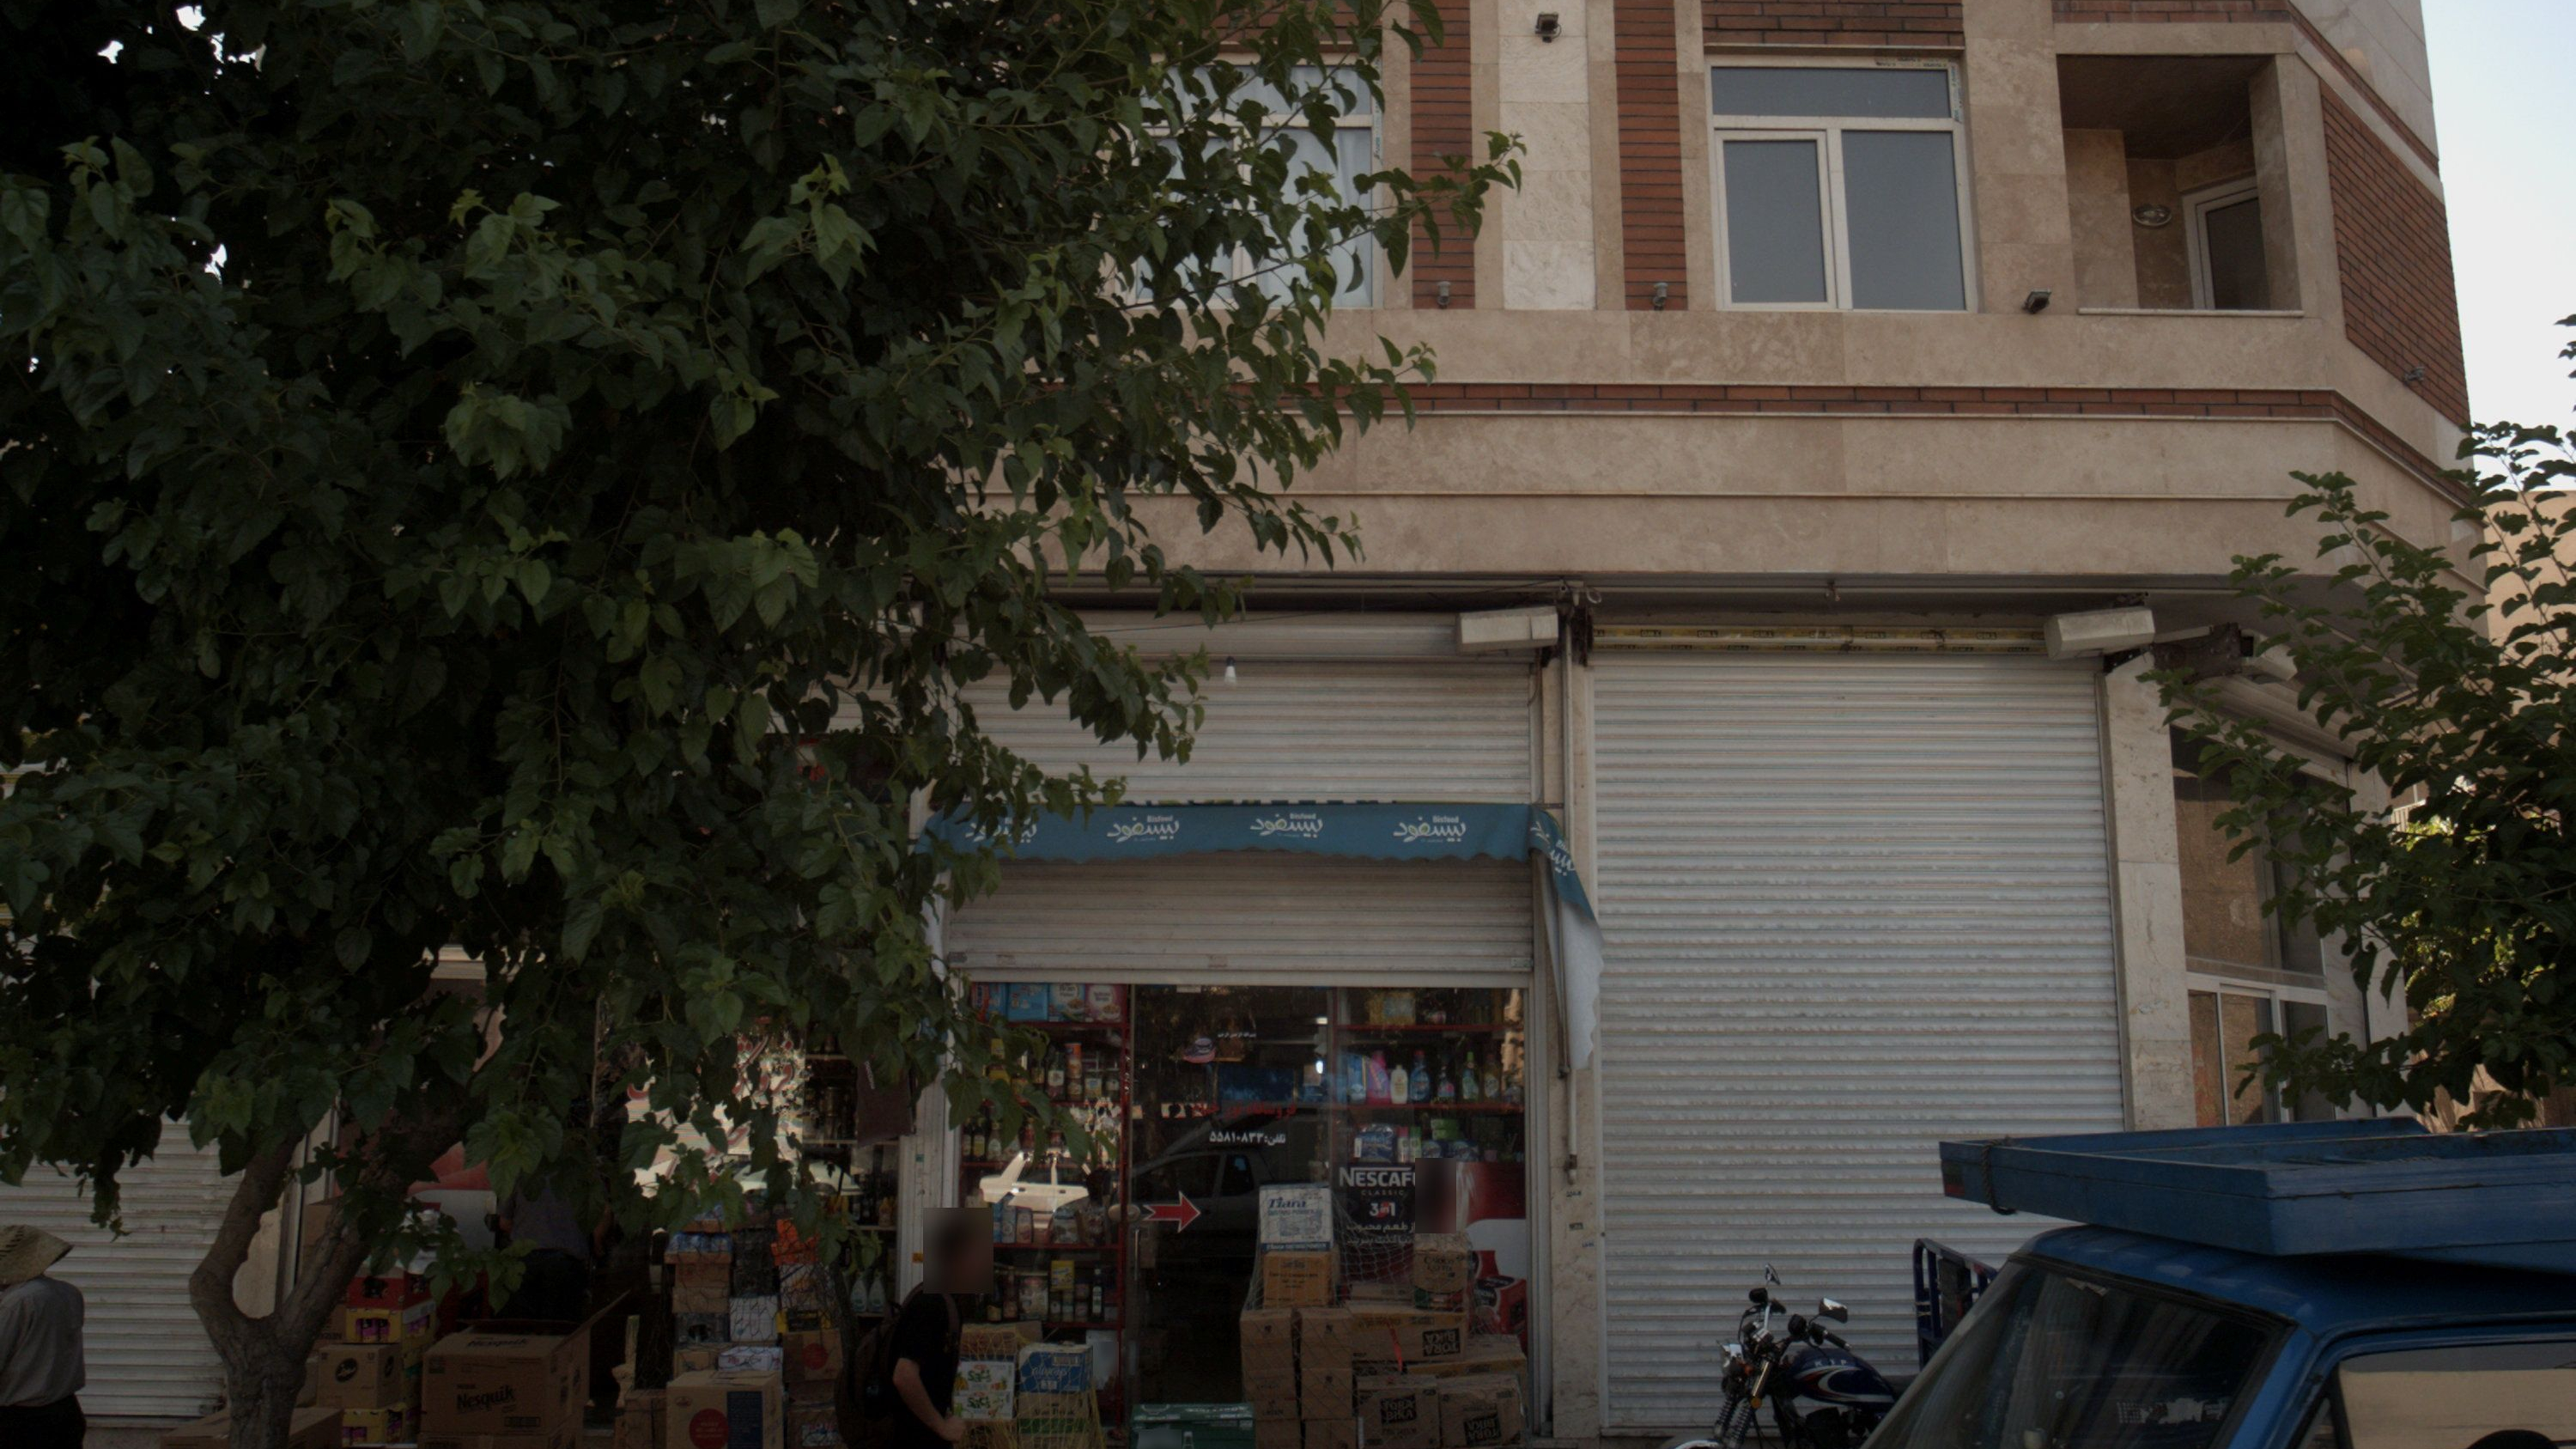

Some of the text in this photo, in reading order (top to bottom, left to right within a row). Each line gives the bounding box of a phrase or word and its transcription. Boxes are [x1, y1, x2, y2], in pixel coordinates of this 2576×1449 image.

[1107, 817, 1180, 843] بیسفود
[1250, 813, 1323, 838] بیسفود
[1393, 816, 1467, 843] بیسفود
[1340, 1166, 1415, 1187] NESCAF
[457, 1385, 514, 1413] Nesquik
